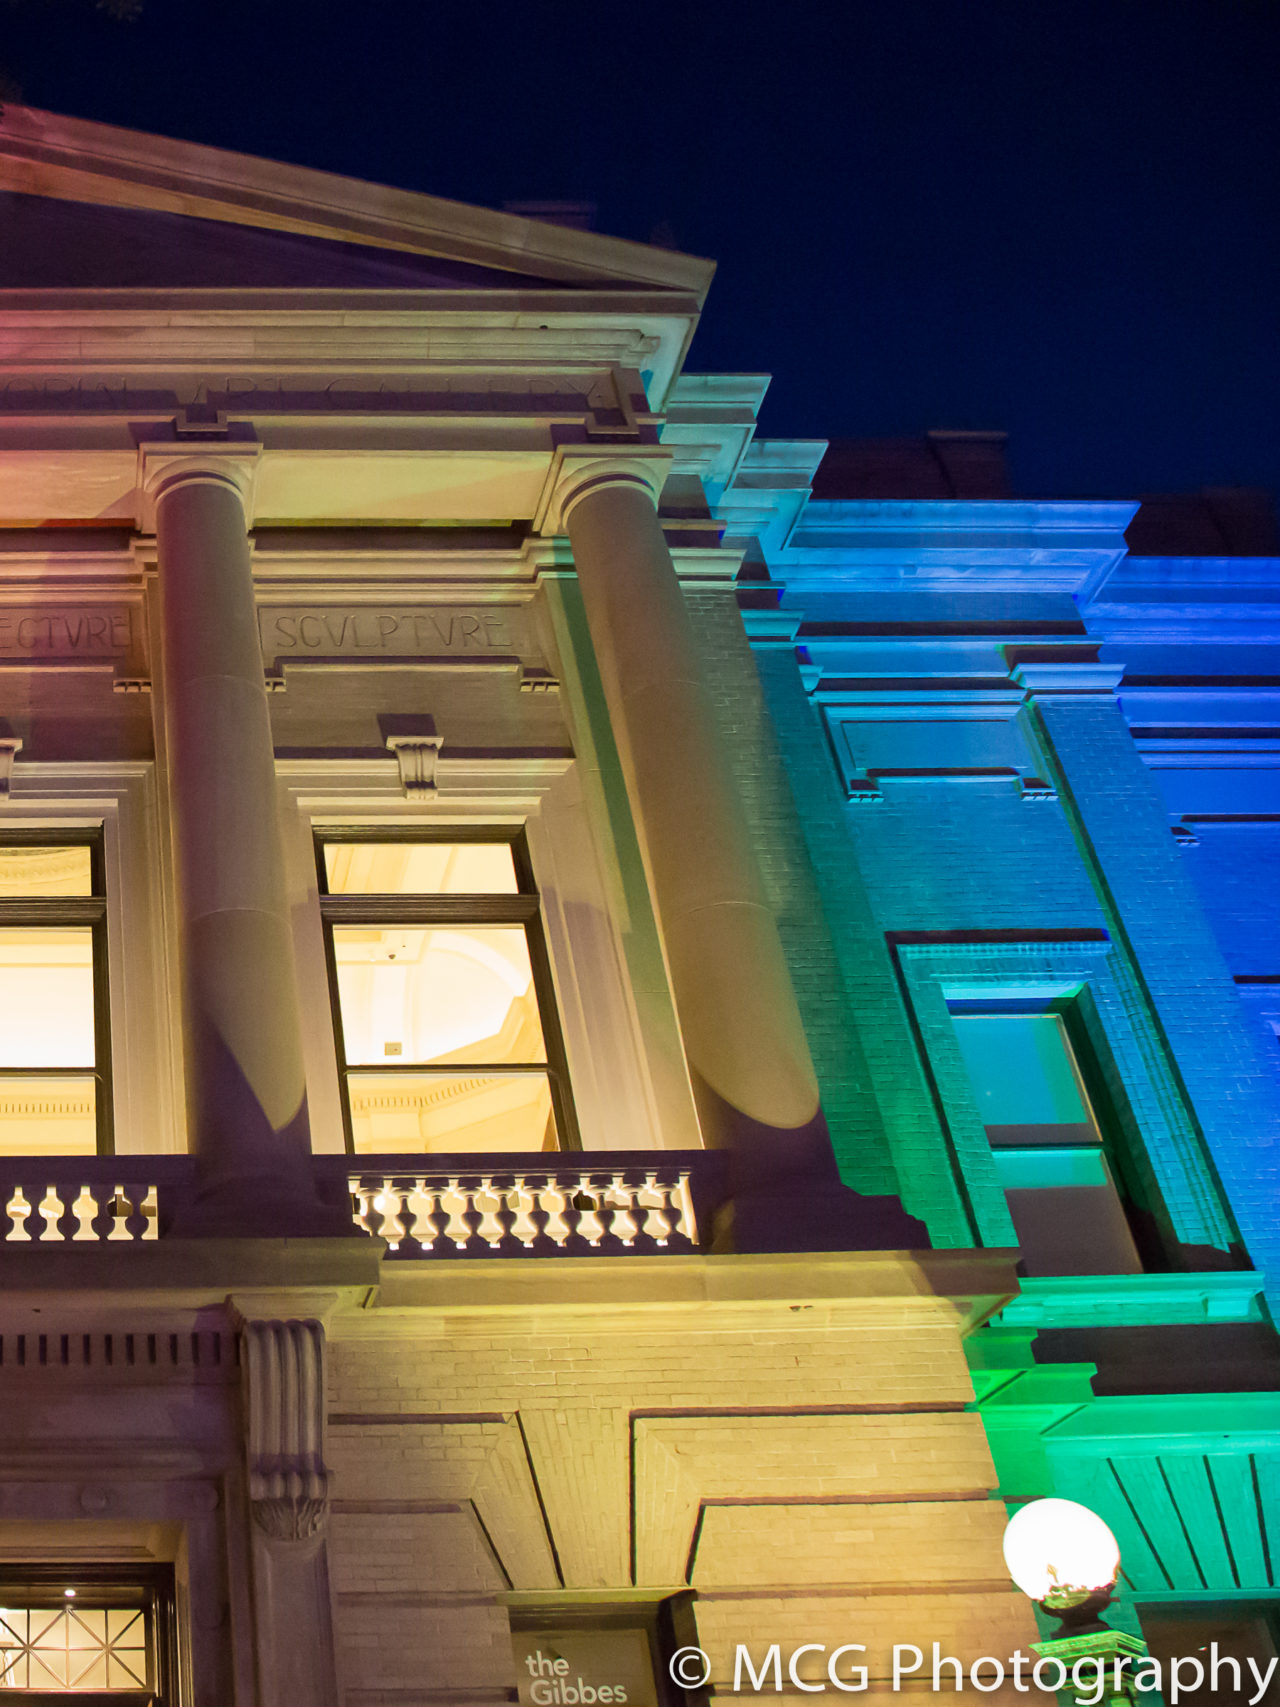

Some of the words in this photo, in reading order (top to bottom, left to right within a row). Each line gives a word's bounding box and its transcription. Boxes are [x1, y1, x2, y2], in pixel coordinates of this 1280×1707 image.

[275, 614, 513, 648] SCVLPTVRE
[525, 1650, 570, 1677] the
[529, 1677, 628, 1705] Gibbes
